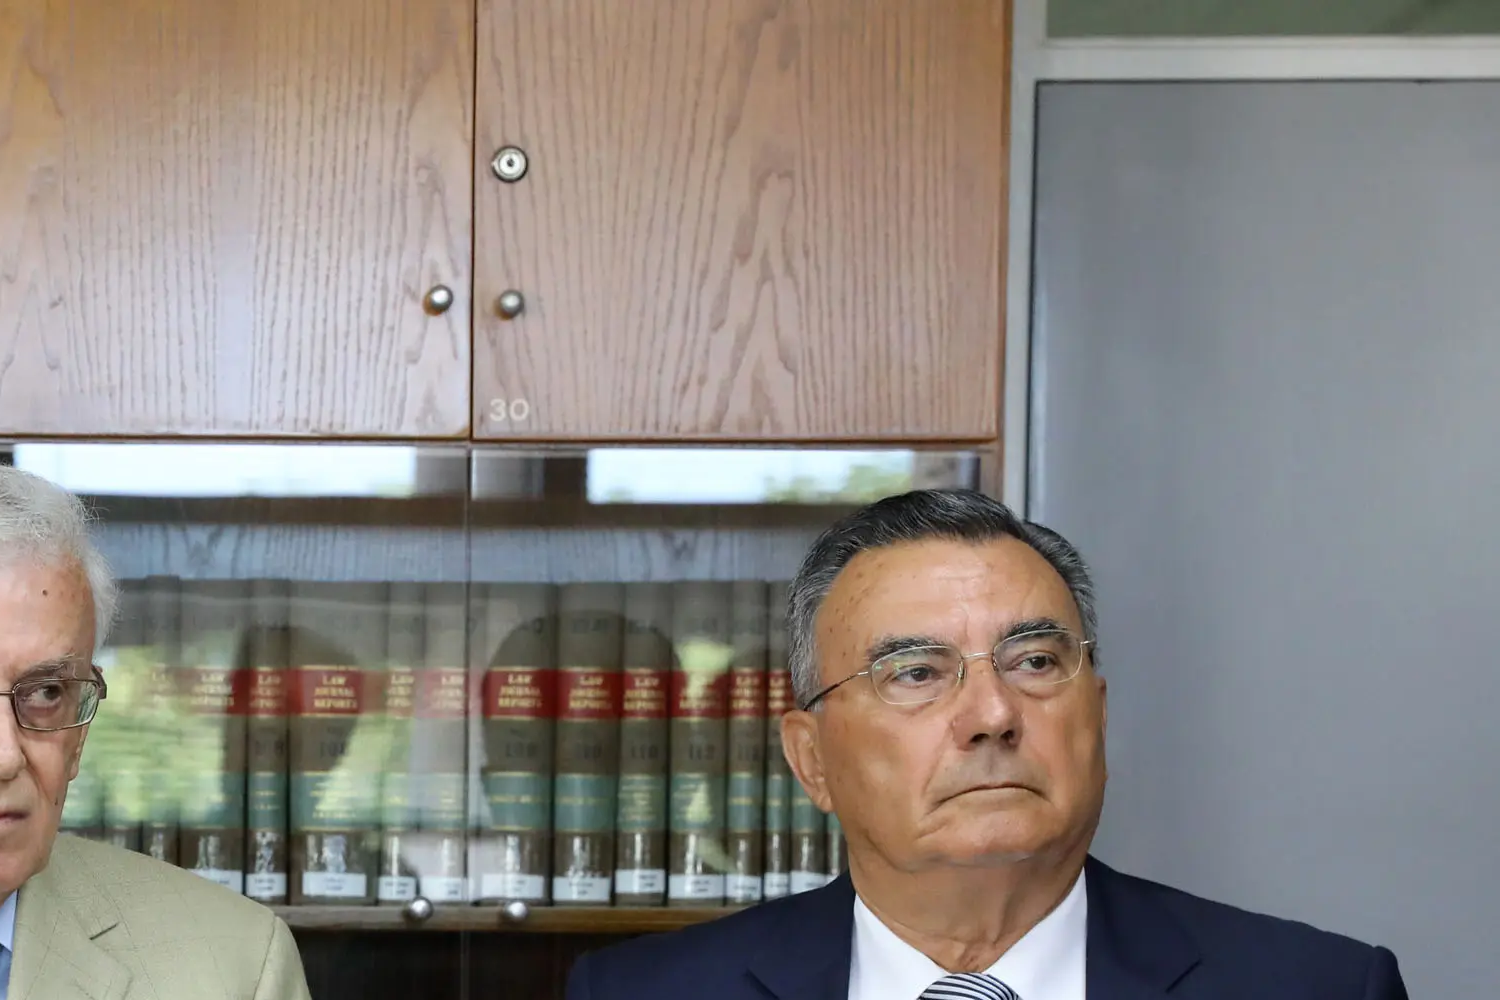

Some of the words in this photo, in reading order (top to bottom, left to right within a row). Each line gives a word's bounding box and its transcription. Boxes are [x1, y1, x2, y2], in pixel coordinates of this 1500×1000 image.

[489, 398, 530, 421] 30
[322, 675, 347, 685] LAW
[508, 674, 533, 684] LAW
